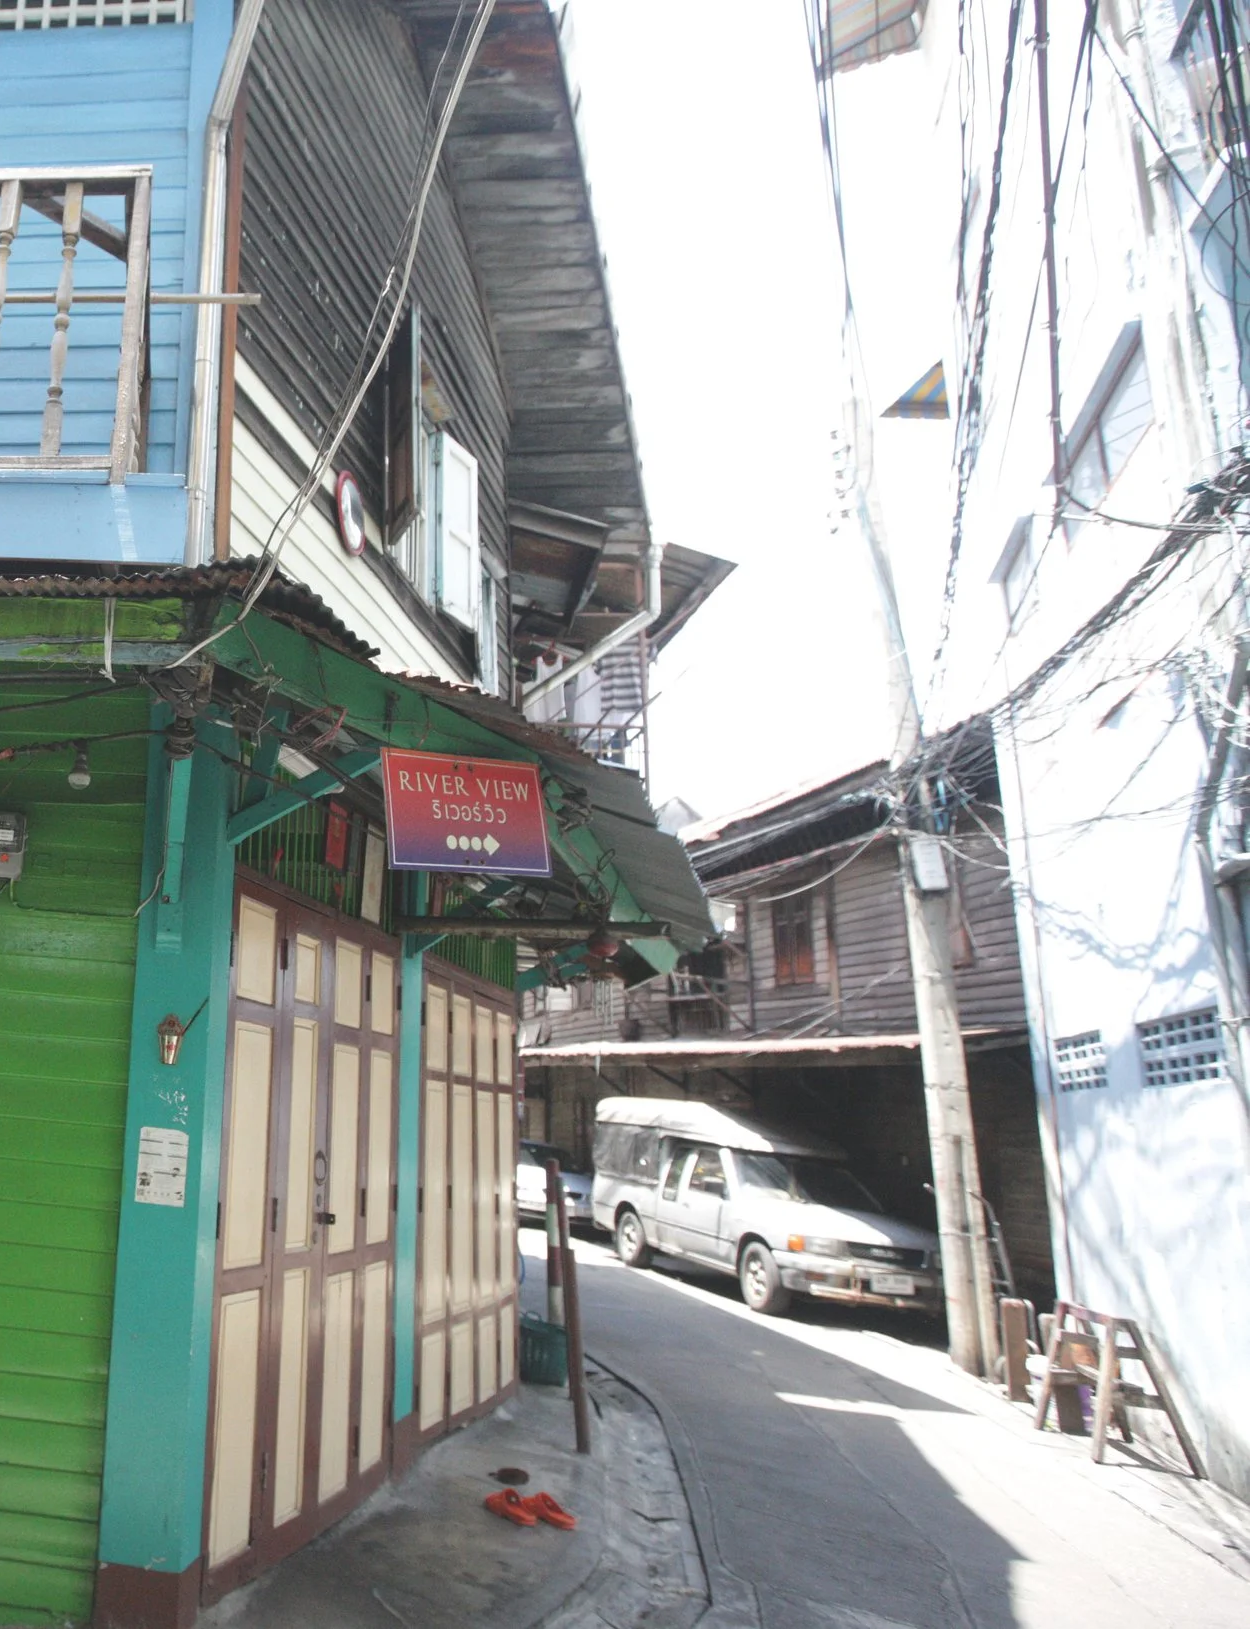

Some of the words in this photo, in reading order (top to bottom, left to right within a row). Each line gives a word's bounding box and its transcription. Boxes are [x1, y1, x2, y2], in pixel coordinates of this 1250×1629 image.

[399, 770, 470, 797] RIVER
[476, 778, 529, 802] VIEW
[432, 799, 507, 824] ริเวอร์วิว
